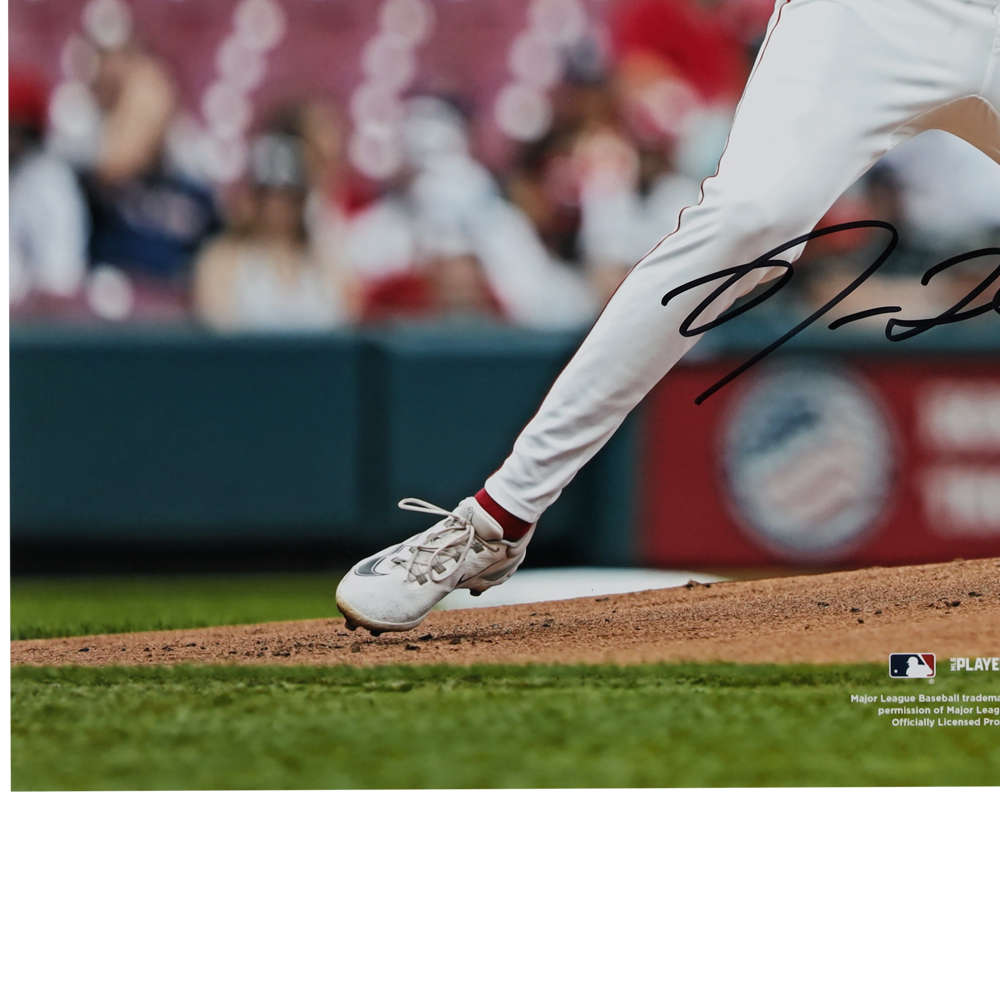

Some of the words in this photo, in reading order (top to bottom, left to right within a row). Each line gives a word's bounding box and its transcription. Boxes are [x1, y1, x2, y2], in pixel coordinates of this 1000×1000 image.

[850, 694, 878, 704] Major
[880, 694, 916, 704] League
[918, 694, 960, 702] Baseball
[878, 706, 931, 716] permission
[933, 706, 944, 714] of
[946, 706, 974, 715] Major
[891, 718, 935, 728] Officially
[937, 718, 981, 726] Licensed
